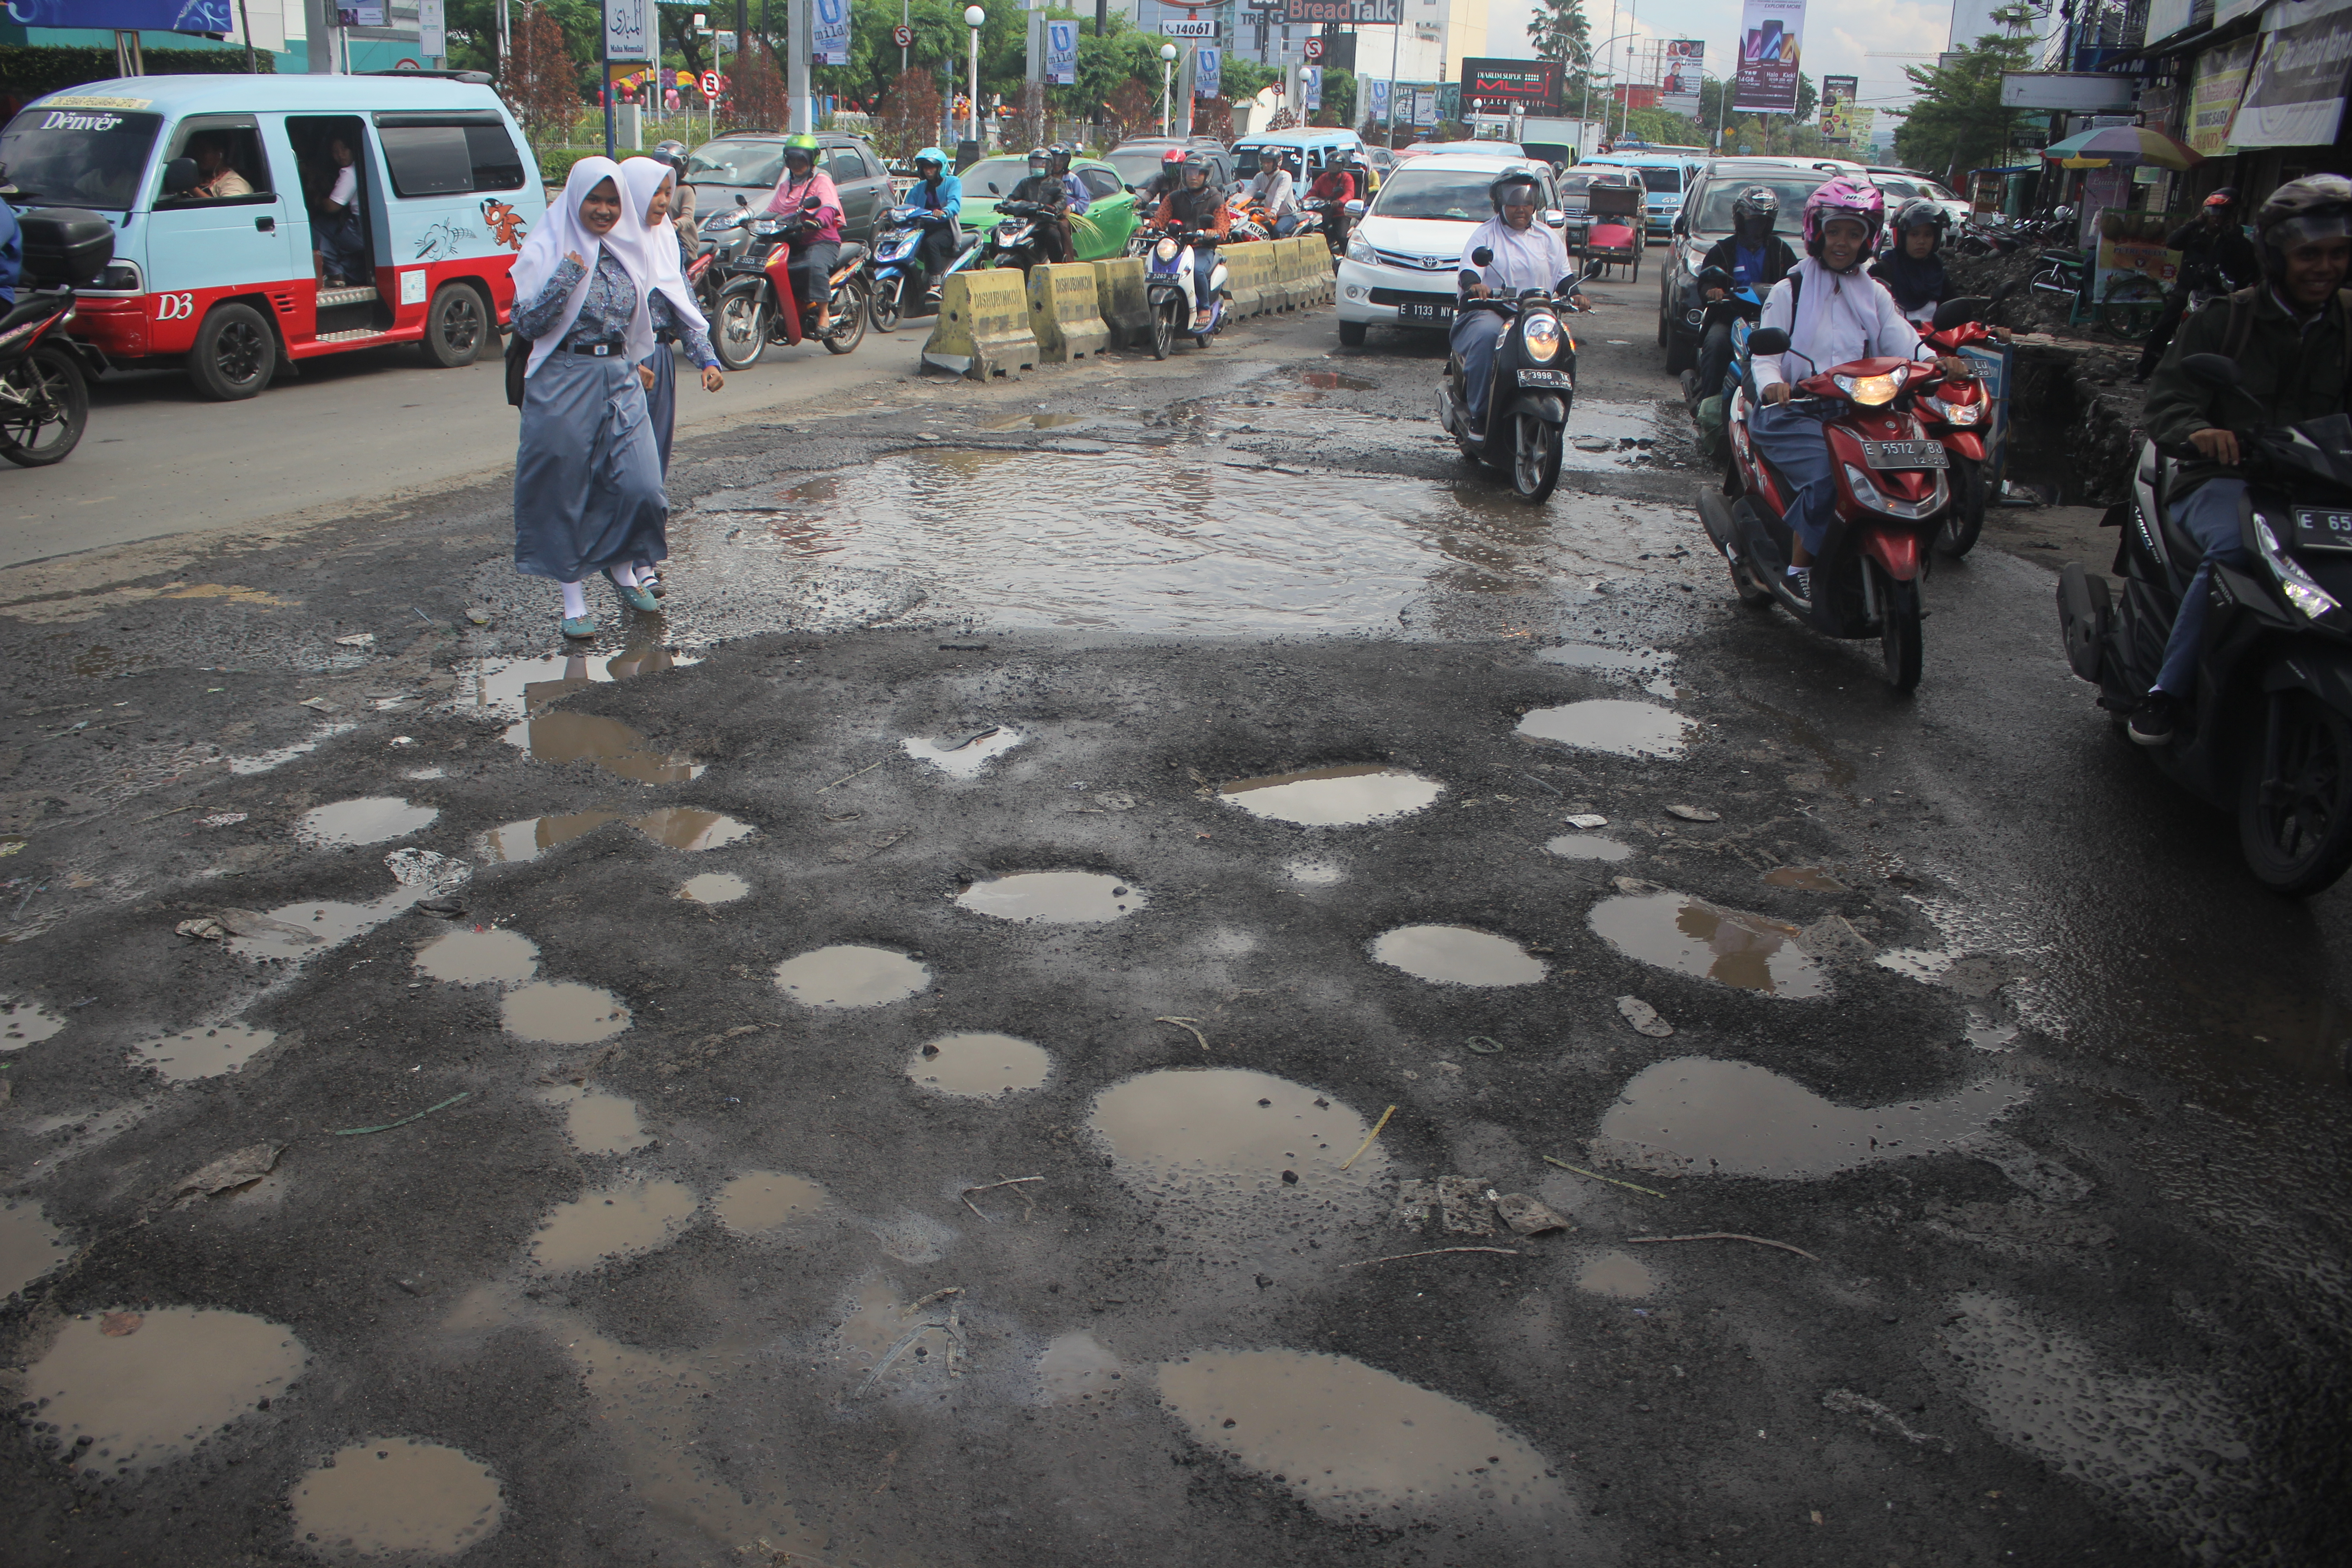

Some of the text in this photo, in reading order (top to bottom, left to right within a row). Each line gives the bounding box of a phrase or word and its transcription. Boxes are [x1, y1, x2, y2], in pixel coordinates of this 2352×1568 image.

[1290, 0, 1396, 21] BreadTalk
[1241, 13, 1284, 24] TREND
[814, 24, 844, 40] mild
[1176, 23, 1210, 34] 14061
[624, 44, 643, 53] Memulai
[1048, 52, 1073, 64] mild
[2114, 247, 2168, 257] PUTRI MULYA
[1055, 275, 1093, 293] DISHUBINKOM
[974, 289, 1021, 309] DISHUBINKOM
[155, 292, 193, 320] D3
[1401, 304, 1451, 317] E 1133 NY
[1975, 361, 1988, 369] LU
[1520, 371, 1525, 379] E
[1531, 371, 1552, 380] 3998
[1864, 443, 1874, 455] E
[1882, 443, 1915, 455] 5572
[2300, 514, 2313, 529] E
[2213, 573, 2234, 605] HONDA
